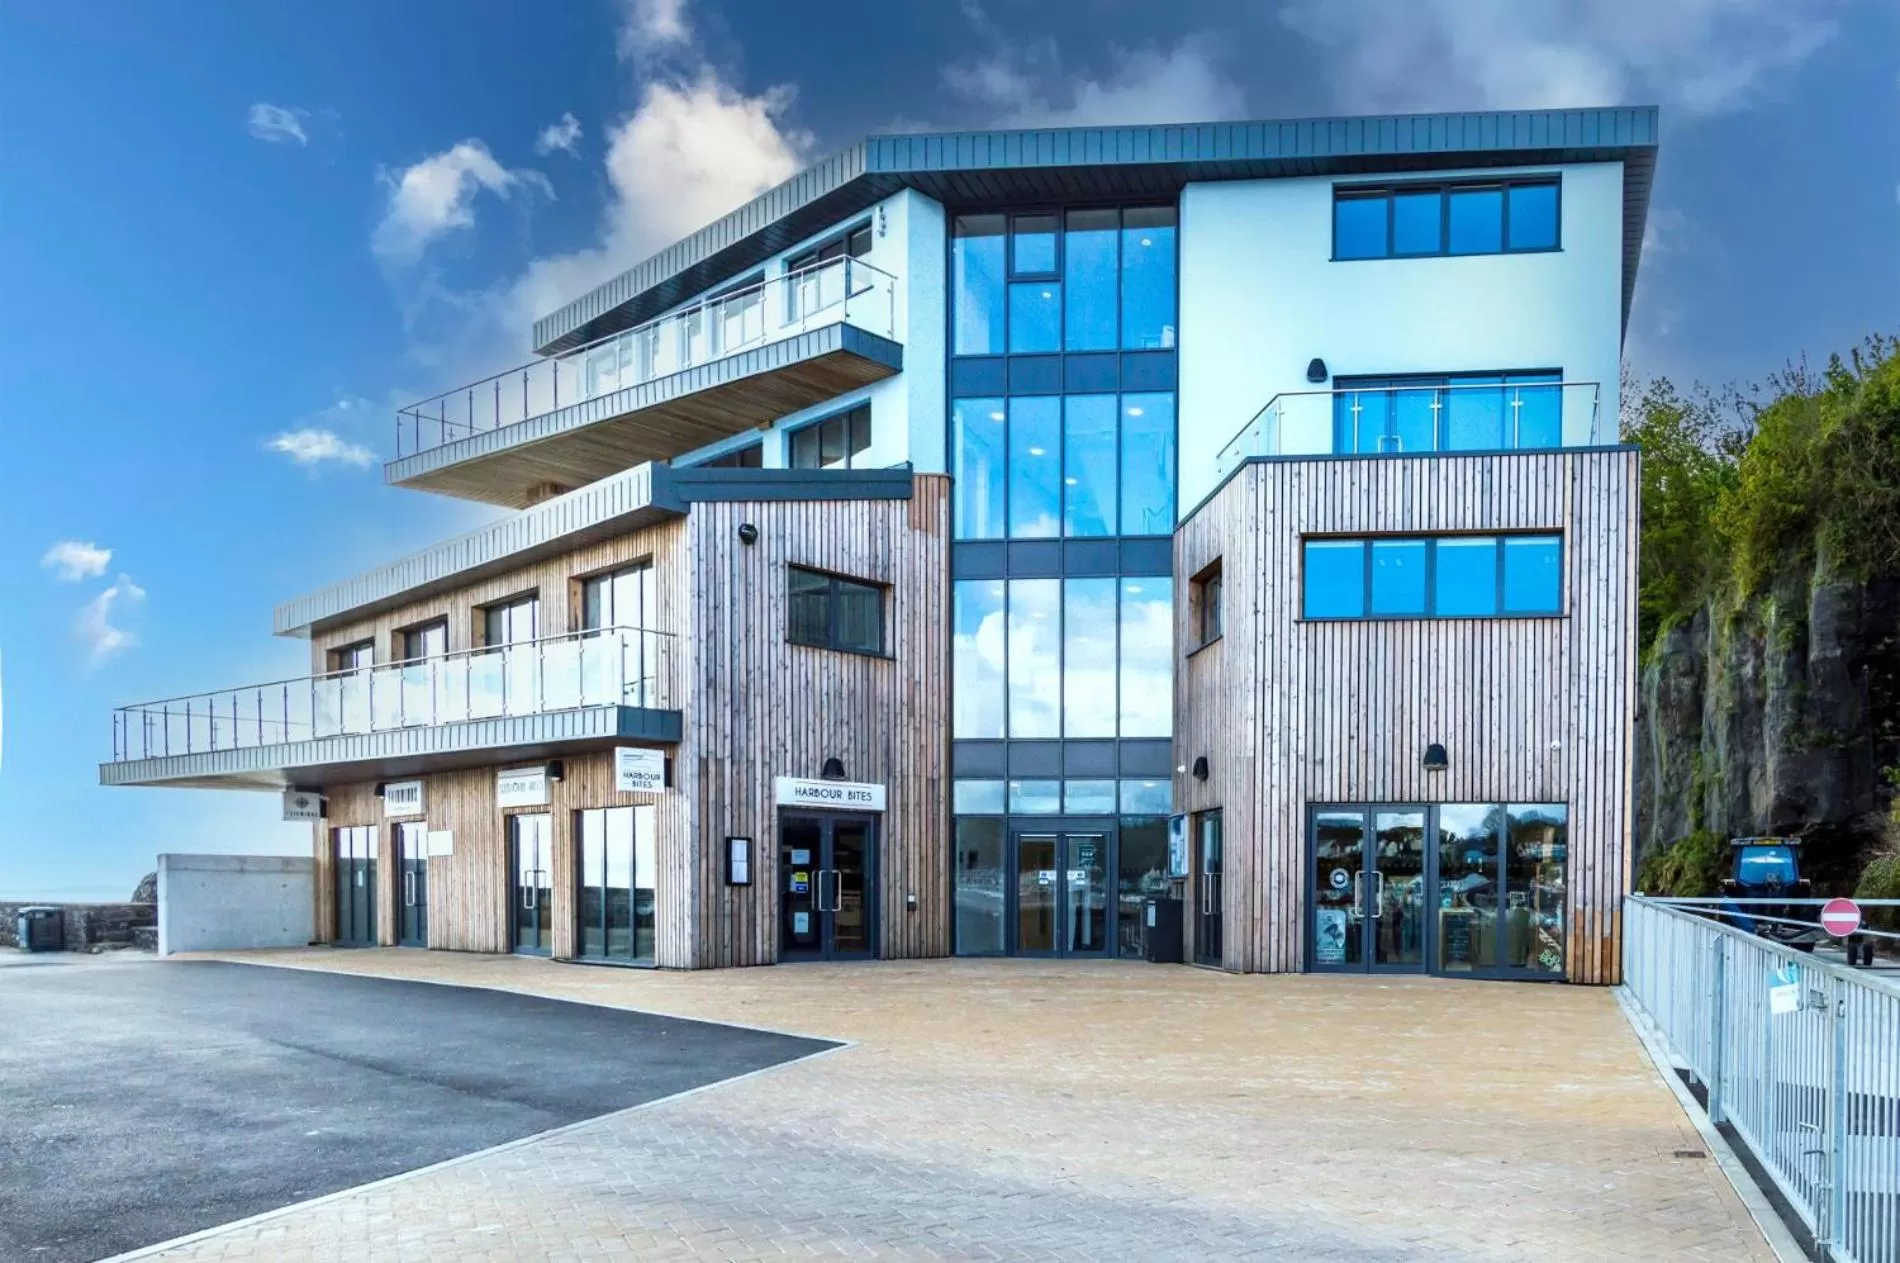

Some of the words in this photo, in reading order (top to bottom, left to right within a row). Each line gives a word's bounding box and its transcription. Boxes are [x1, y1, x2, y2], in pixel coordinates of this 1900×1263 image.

[623, 771, 661, 781] HARBOUR
[632, 780, 653, 789] BITES
[795, 787, 843, 800] HARBOUR
[848, 791, 872, 801] BITES
